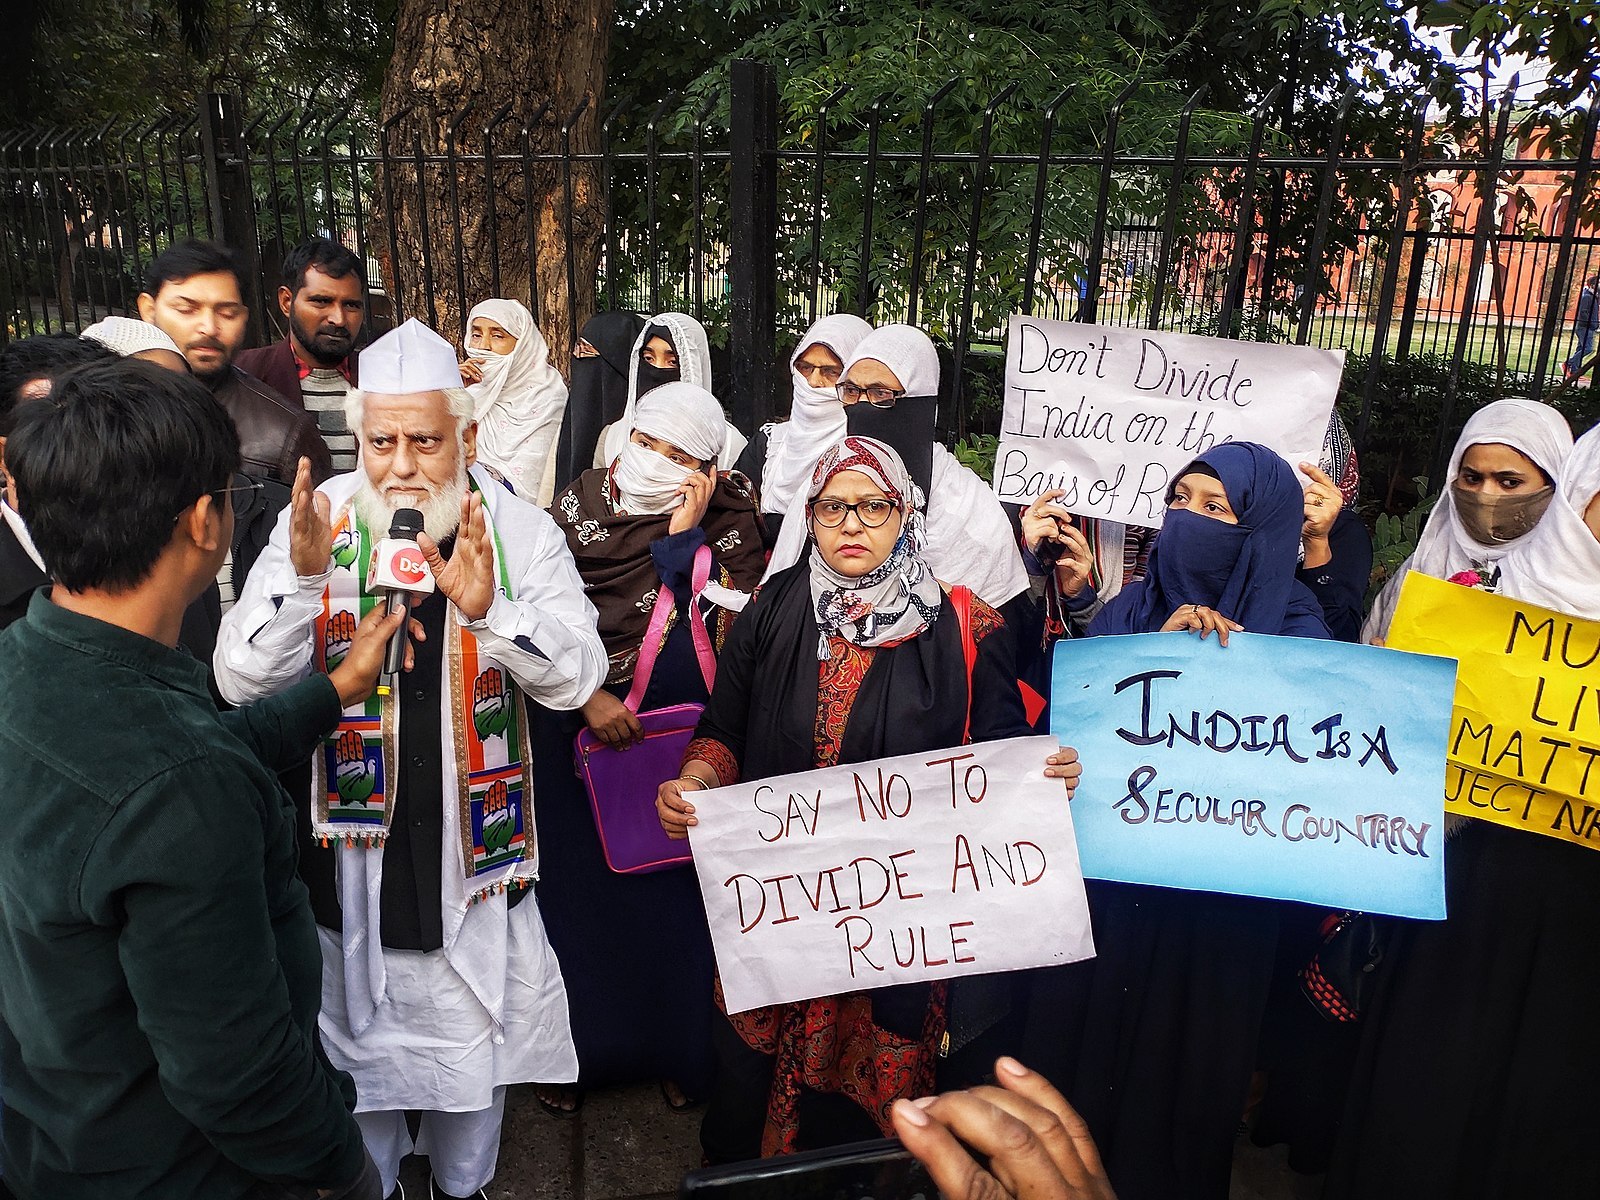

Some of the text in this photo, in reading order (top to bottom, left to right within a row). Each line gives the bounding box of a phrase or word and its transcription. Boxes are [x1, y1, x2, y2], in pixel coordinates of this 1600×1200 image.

[1018, 324, 1252, 407] Don't Divide
[1005, 385, 1115, 443] India
[1125, 412, 1168, 446] on
[998, 449, 1079, 507] Basis
[1087, 463, 1126, 515] of
[1114, 669, 1309, 764] INDIA
[1357, 725, 1399, 775] A
[754, 753, 988, 842] SAY NO TO
[1112, 765, 1433, 858] SECULAR COUNTARY
[1444, 764, 1546, 821] JECT
[724, 834, 1047, 934] DIVIDE AND
[834, 915, 976, 979] RULE
